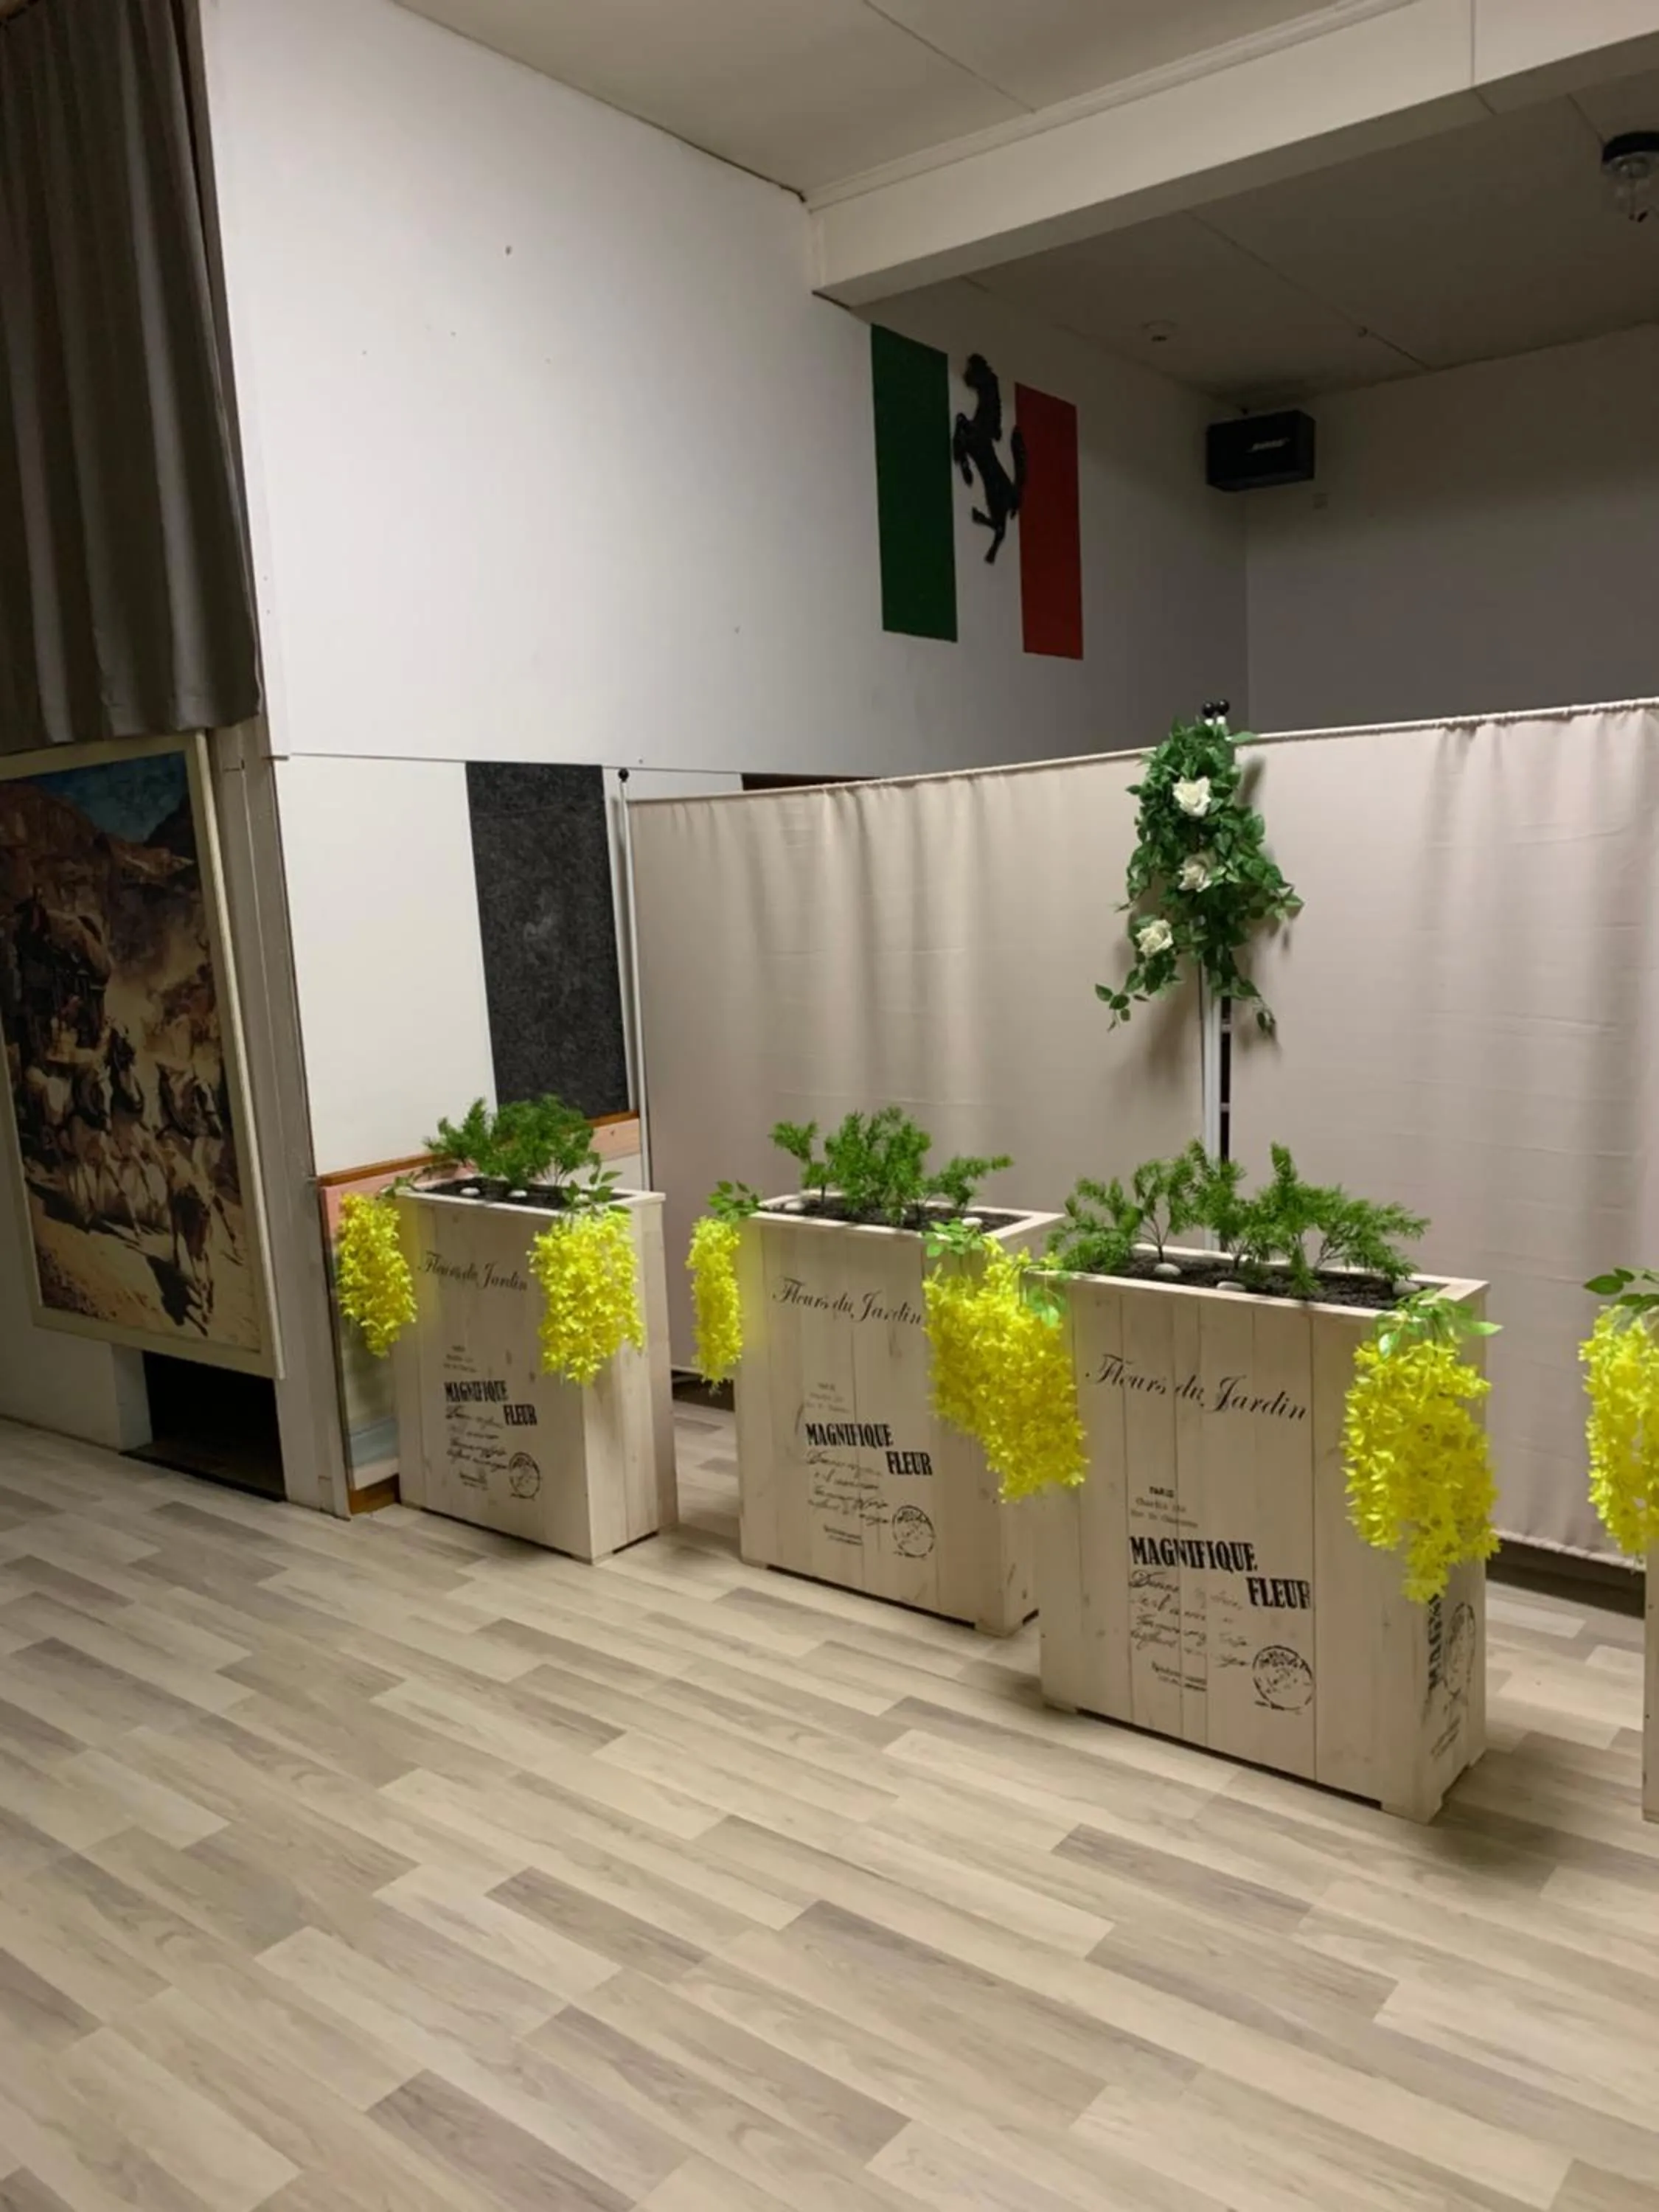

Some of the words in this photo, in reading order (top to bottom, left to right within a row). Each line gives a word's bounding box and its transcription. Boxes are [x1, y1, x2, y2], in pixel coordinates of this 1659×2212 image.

[1086, 1353, 1166, 1394] Fleurs
[1175, 1374, 1204, 1401] du
[1202, 1374, 1307, 1421] Jardin
[503, 1403, 538, 1426] FLEUR
[805, 1422, 894, 1450] MAGNIFIQUE
[886, 1450, 933, 1476] FLEUR
[1129, 1535, 1259, 1574] MAGNIFIQUE
[1245, 1576, 1311, 1610] FLEUR
